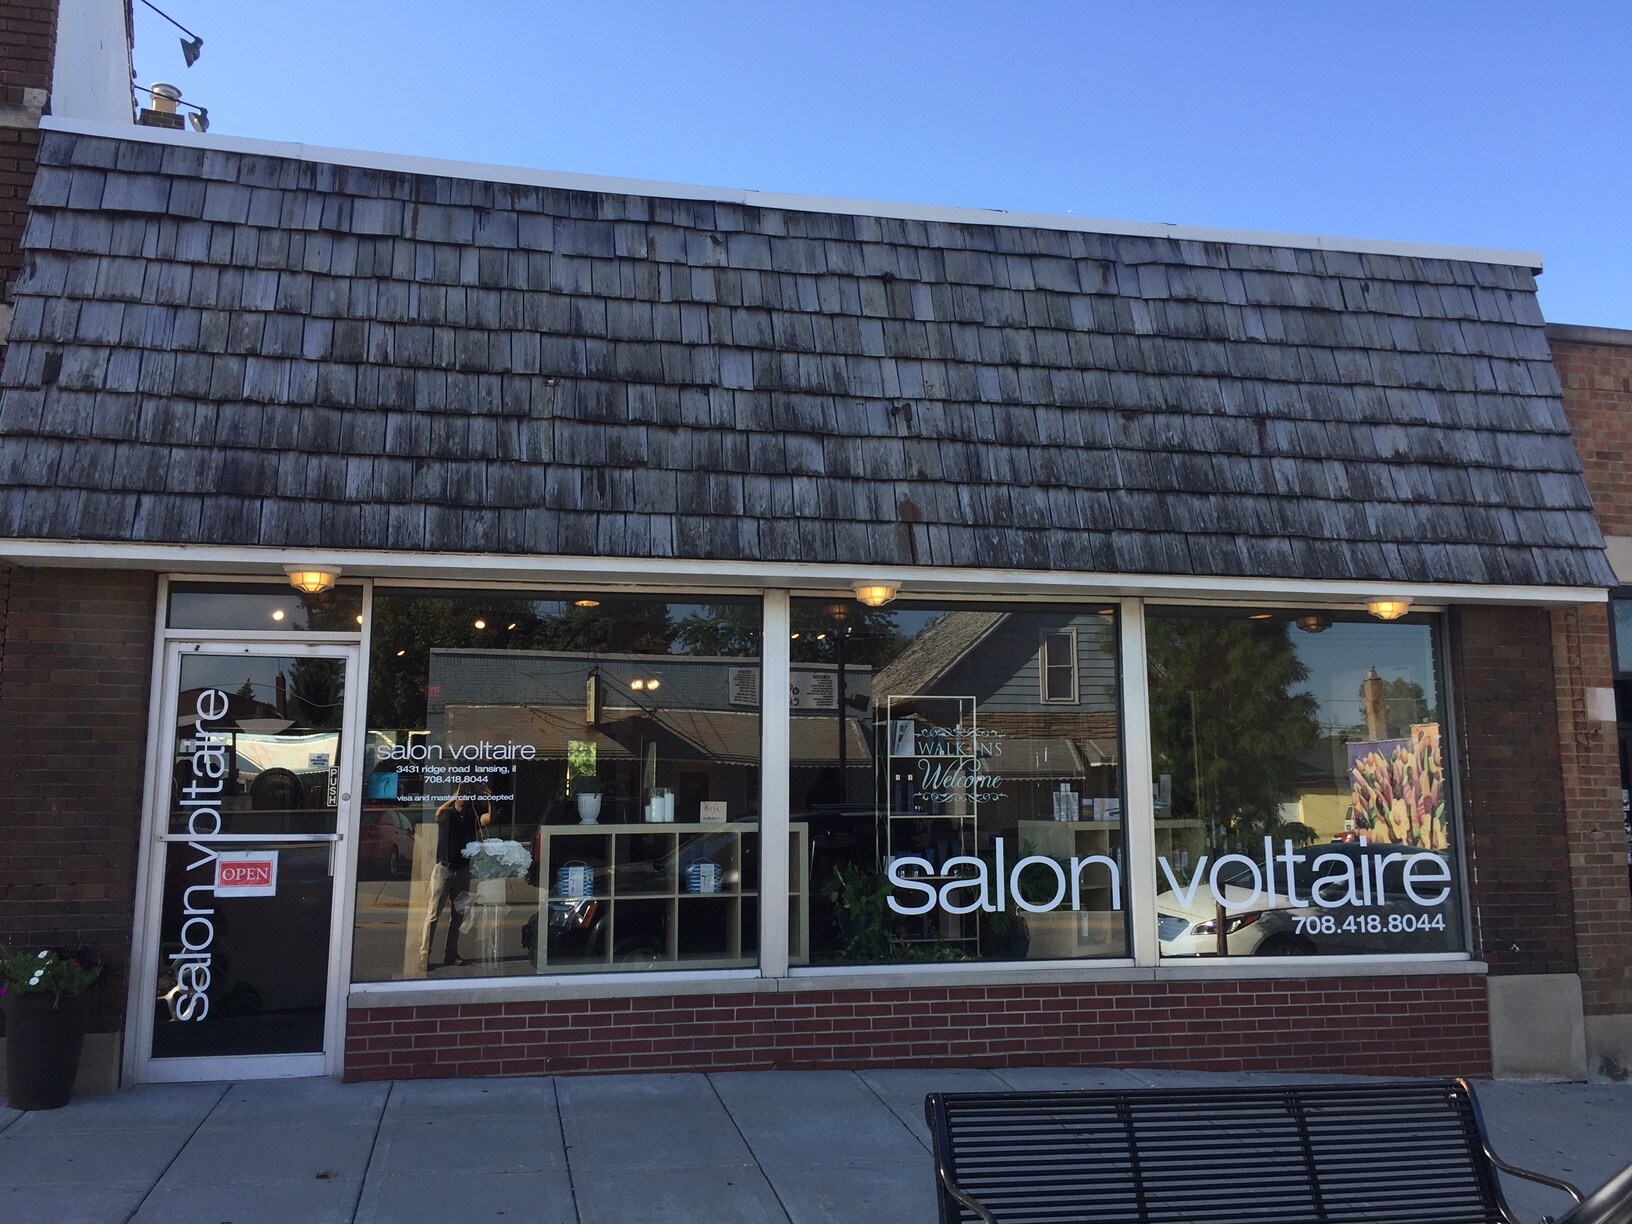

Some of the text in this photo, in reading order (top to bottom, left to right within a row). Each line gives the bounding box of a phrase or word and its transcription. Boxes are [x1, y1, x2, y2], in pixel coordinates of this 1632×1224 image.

[376, 741, 536, 760] salon voltaire
[396, 765, 420, 773] 3431
[421, 765, 446, 775] ridge
[448, 765, 470, 773] road
[475, 765, 510, 775] lansing,
[424, 775, 489, 784] 708.418.8044
[918, 758, 1002, 790] Welcome
[329, 769, 338, 804] PUSH
[397, 794, 514, 803] visa and mastercard accepted
[169, 689, 229, 1022] salon voltaire
[222, 867, 269, 881] OPEN
[886, 835, 1452, 915] salon voltaire
[1291, 913, 1446, 936] 708.418.8044
